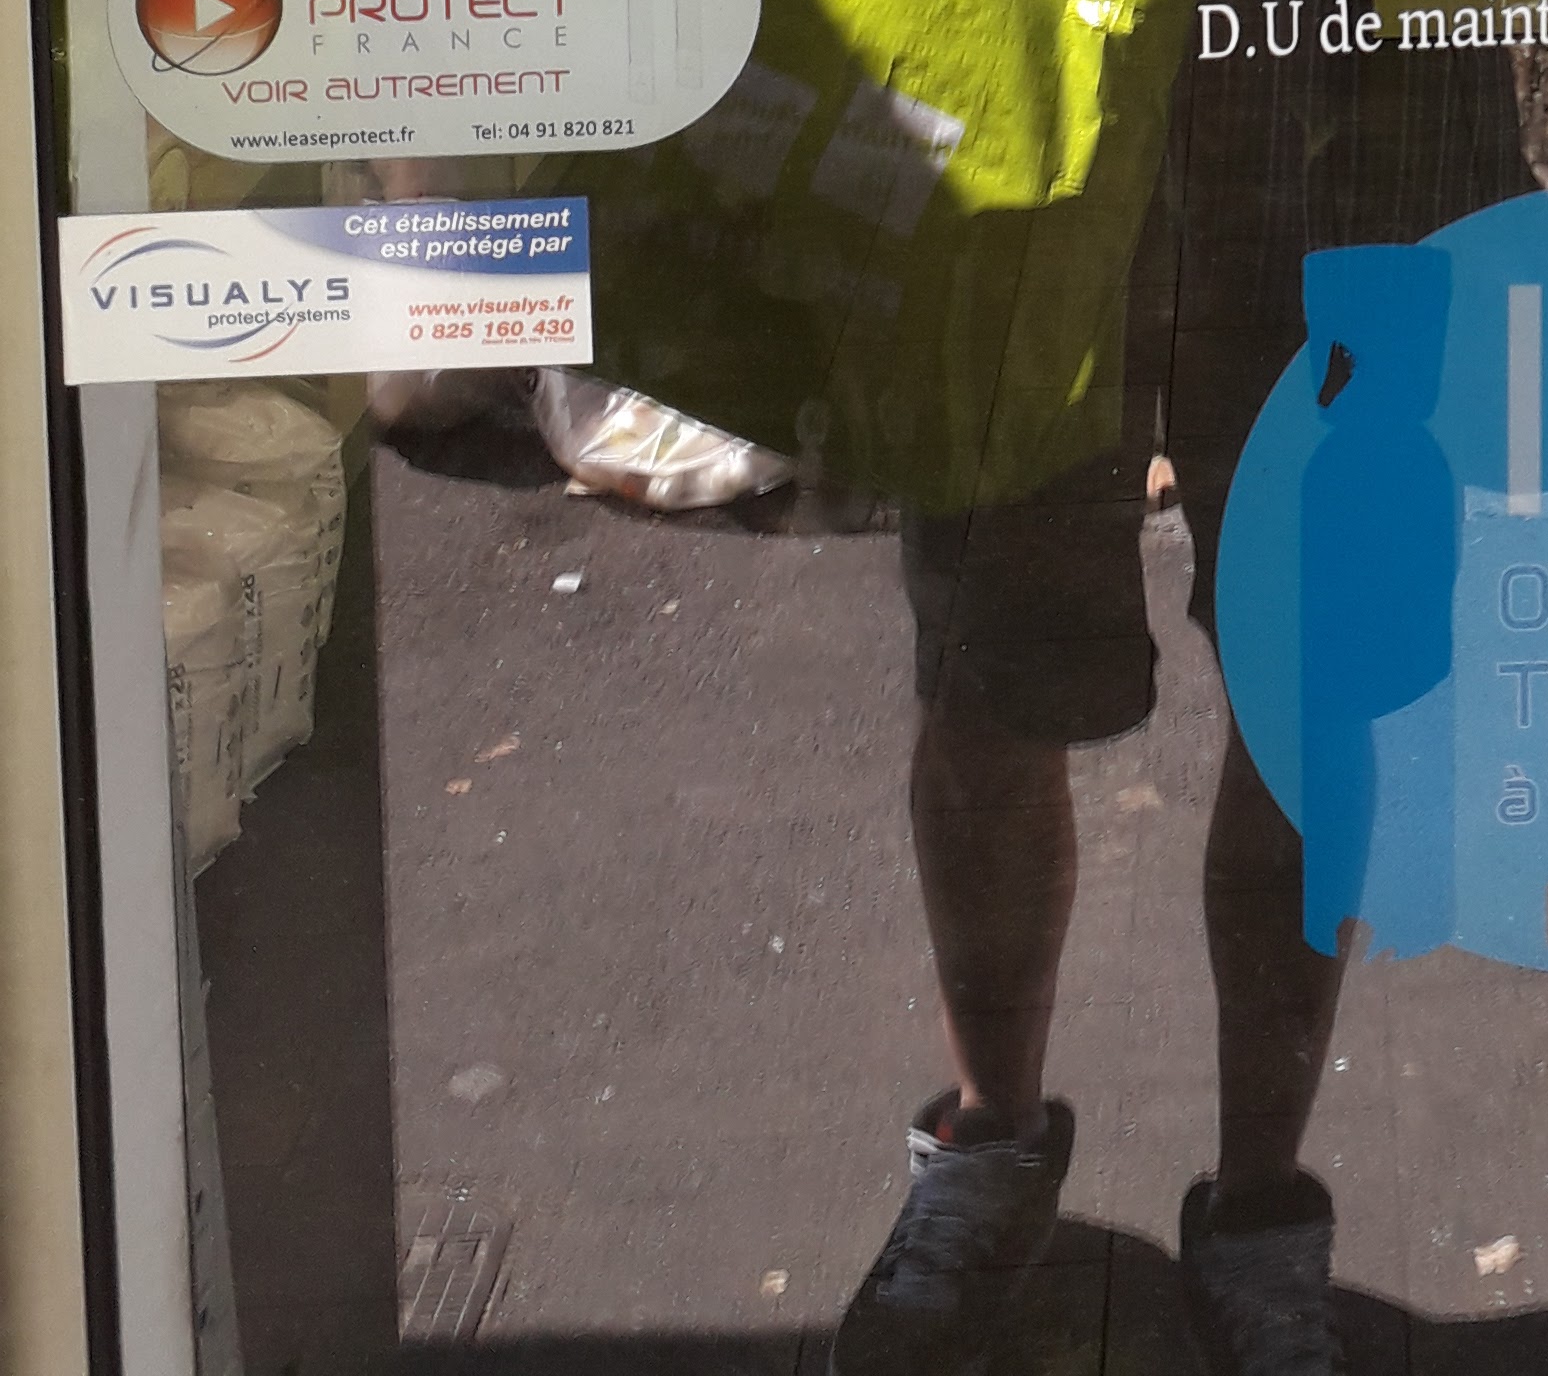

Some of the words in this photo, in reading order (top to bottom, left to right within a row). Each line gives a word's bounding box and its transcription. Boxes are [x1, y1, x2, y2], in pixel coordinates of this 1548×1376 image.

[1198, 3, 1303, 61] D.U
[1320, 0, 1386, 55] de
[220, 78, 309, 106] VOIR
[230, 124, 416, 153] www.leaseprotect.fr
[472, 123, 503, 142] Tel:
[508, 122, 531, 140] 04
[535, 121, 558, 140] 91
[562, 120, 597, 139] 820
[601, 118, 635, 138] 821
[343, 214, 390, 236] Cet
[395, 208, 571, 234] établissement
[380, 238, 421, 260] est
[424, 232, 523, 263] protégé
[528, 234, 572, 258] par
[90, 277, 352, 311] VISUALYS
[408, 295, 575, 321] www.visualys.fr
[207, 312, 271, 331] protect
[274, 307, 352, 328] systems
[408, 324, 424, 341] 0
[430, 322, 473, 341] 825
[483, 319, 524, 338] 160
[532, 317, 575, 337] 430
[1496, 766, 1539, 826] à
